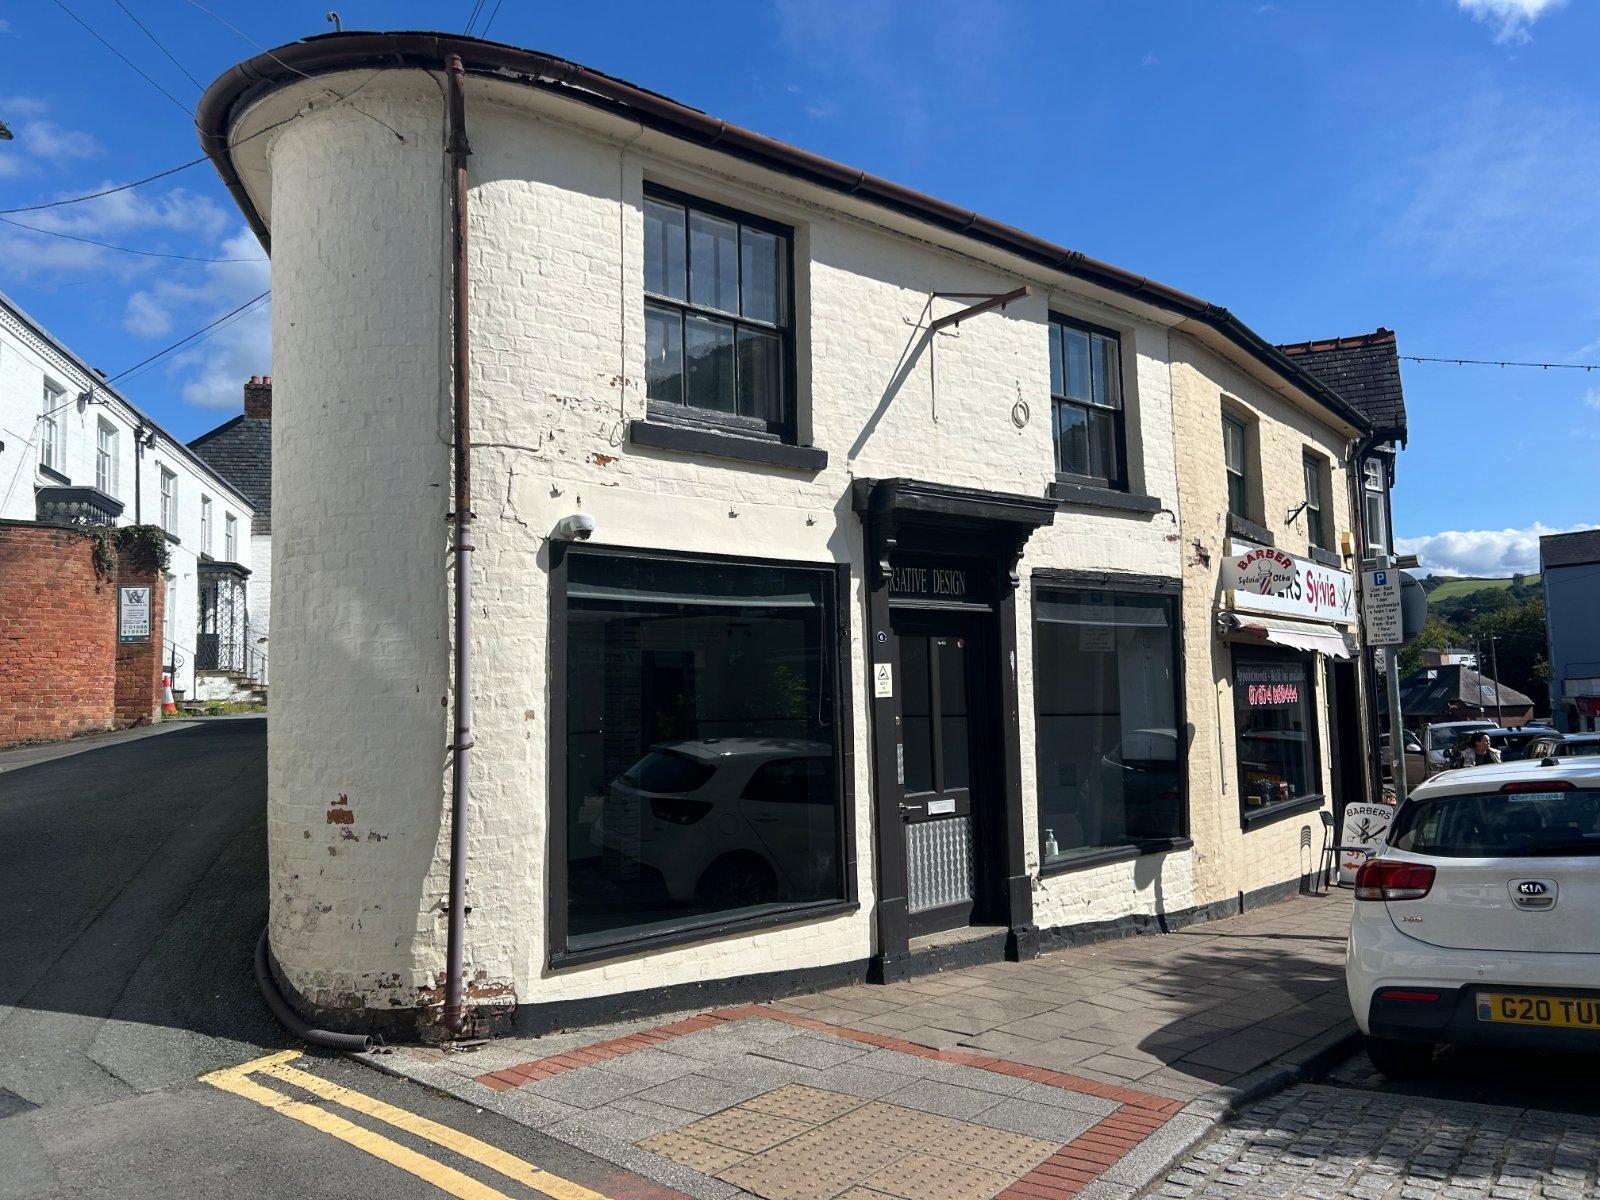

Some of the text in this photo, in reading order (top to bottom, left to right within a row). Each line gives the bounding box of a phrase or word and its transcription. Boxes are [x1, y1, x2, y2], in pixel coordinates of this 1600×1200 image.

[1237, 549, 1292, 571] BARBER
[933, 569, 966, 595] DESIGN
[1238, 576, 1260, 586] Sylvia
[1377, 573, 1384, 584] P
[1346, 806, 1392, 820] BARBERS
[1521, 883, 1544, 893] KIA
[1501, 997, 1600, 1025] G20 TU
